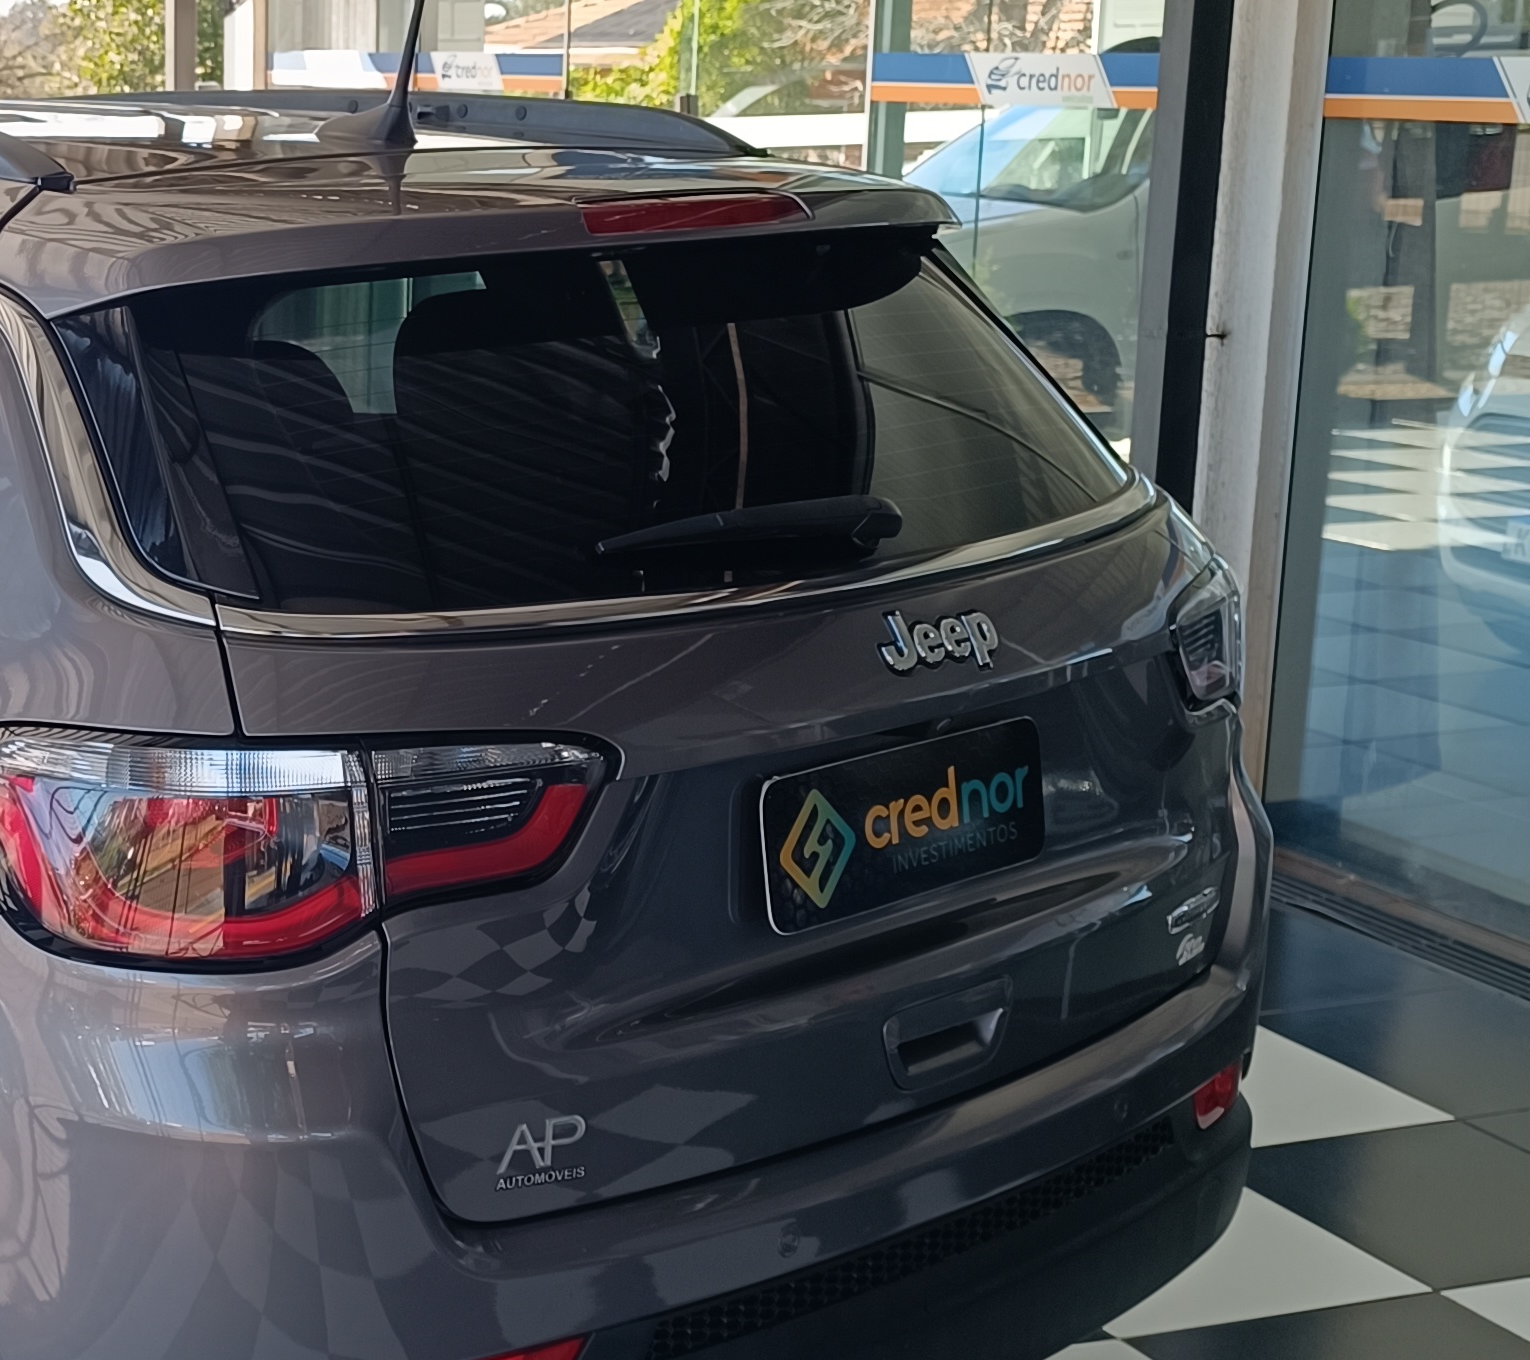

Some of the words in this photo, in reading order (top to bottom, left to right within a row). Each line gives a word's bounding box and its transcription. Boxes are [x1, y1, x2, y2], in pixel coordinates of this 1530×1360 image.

[1016, 66, 1096, 92] crednor
[876, 609, 999, 675] Jeep
[865, 765, 1030, 849] crednor
[892, 821, 1018, 874] INVESTIMENTOS
[496, 1114, 586, 1175] AP
[496, 1166, 585, 1191] AUTOMÓVEIS
